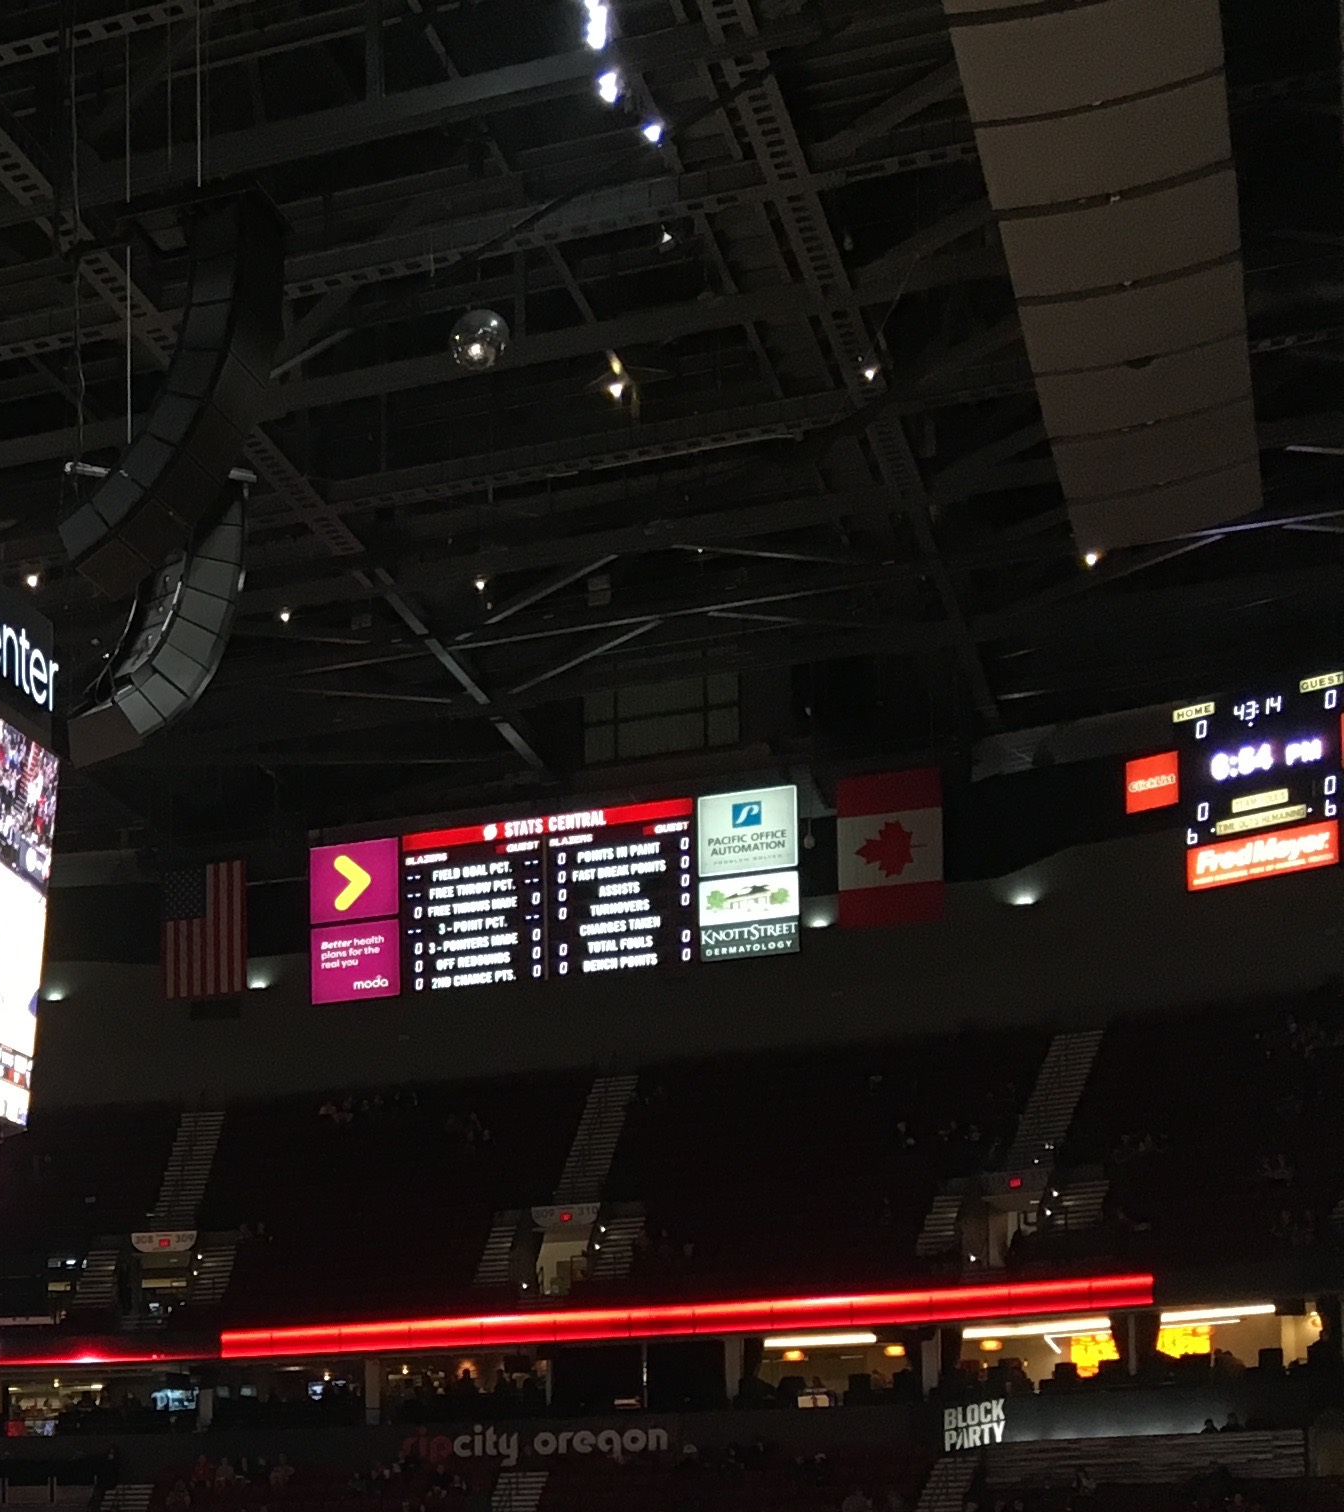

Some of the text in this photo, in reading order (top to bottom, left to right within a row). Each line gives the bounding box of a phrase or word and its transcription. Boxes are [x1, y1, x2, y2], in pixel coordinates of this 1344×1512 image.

[1300, 673, 1343, 691] GUEST
[1233, 695, 1282, 721] 43:14
[1324, 689, 1337, 710] 0
[1176, 704, 1212, 720] HOME
[1194, 719, 1208, 739] 0
[1324, 775, 1337, 796] 0
[1196, 801, 1210, 822] 0
[503, 809, 607, 839] STATS CENTRAL
[707, 828, 788, 848] PACIFIC OFFICE
[576, 847, 615, 864] POINTS
[710, 839, 787, 857] AUTOMATION
[572, 868, 596, 883] FAST
[630, 859, 667, 875] POINTS
[429, 886, 455, 901] FREE
[598, 881, 641, 899] ASSISTS
[427, 905, 452, 918] FREE
[589, 898, 651, 918] TURNOVERS
[579, 919, 627, 938] CHARGES
[320, 934, 385, 951] Better health
[587, 940, 619, 955] TOTAL
[705, 939, 793, 957] DERMATOLOGY
[320, 945, 381, 962] plans for the
[320, 958, 359, 970] real you
[435, 957, 456, 972] OFF
[582, 952, 659, 974] BENCH POINTS
[352, 974, 389, 991] moda
[943, 1398, 1006, 1430] BLOCK
[943, 1420, 1006, 1452] PARTY
